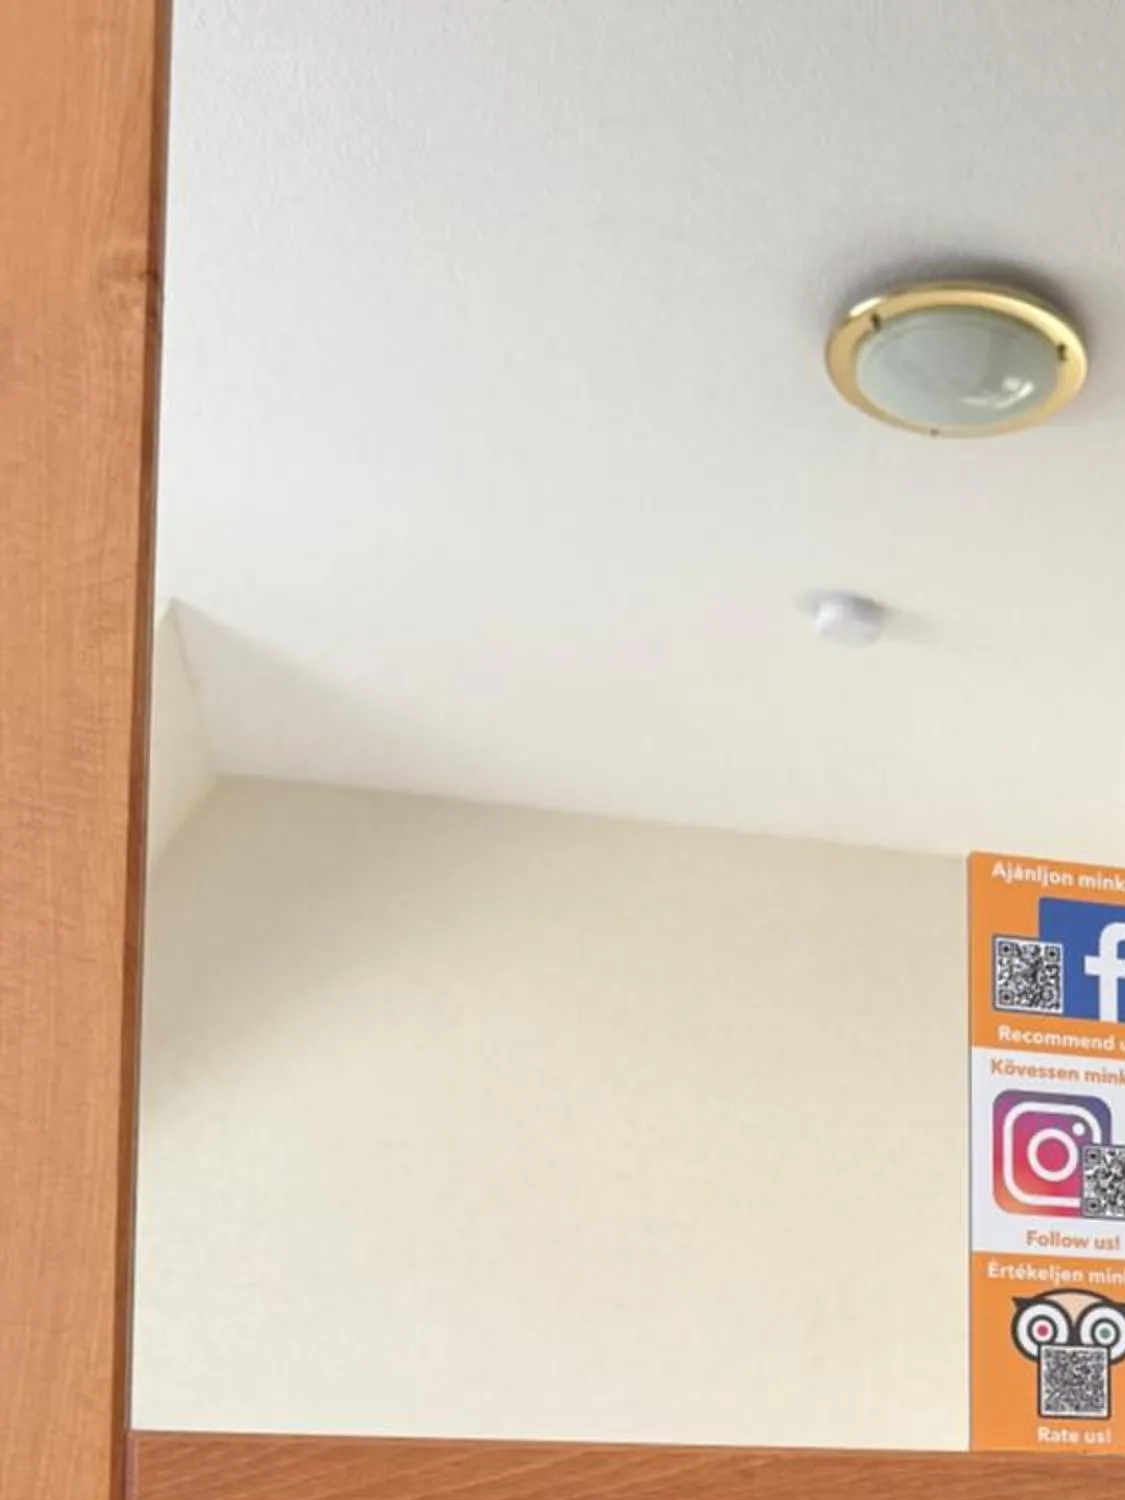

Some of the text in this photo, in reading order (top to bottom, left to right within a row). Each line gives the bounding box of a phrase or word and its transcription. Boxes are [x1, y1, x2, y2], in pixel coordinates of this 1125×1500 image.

[991, 860, 1073, 886] Ajánljon
[998, 1024, 1114, 1051] Recommend
[990, 1058, 1079, 1082] Kövessen
[1026, 1230, 1121, 1250] Follow us!
[987, 1261, 1083, 1284] Értékeljen
[1037, 1426, 1112, 1444] Rate us!
